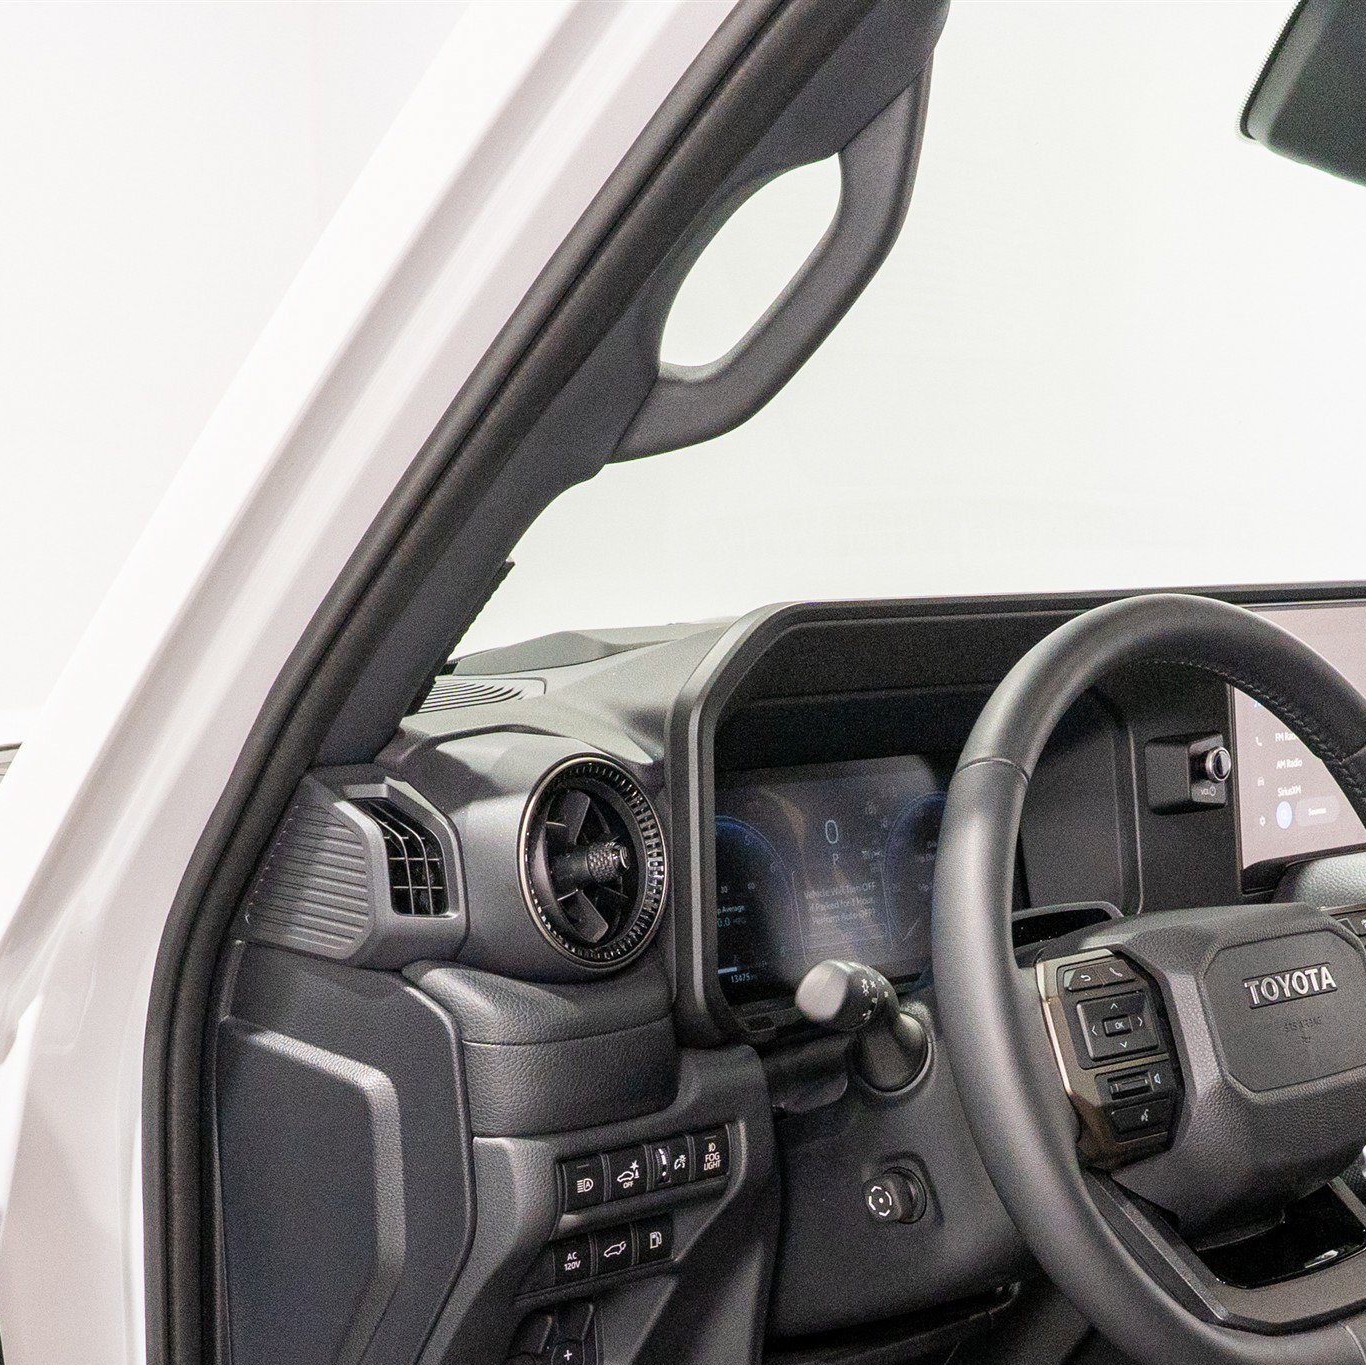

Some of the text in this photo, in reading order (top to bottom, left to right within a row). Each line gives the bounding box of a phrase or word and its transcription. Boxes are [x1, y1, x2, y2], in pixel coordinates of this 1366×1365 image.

[1276, 758, 1303, 769] AM Radio
[1277, 785, 1302, 797] SiriusXM
[824, 819, 839, 845] 0
[1244, 966, 1337, 1005] TOYOTA
[1115, 1020, 1125, 1030] OK
[705, 1151, 721, 1163] FOG
[703, 1159, 722, 1171] LIGHT
[623, 1180, 634, 1189] OFF
[567, 1251, 578, 1262] AC
[564, 1260, 581, 1272] 120V
